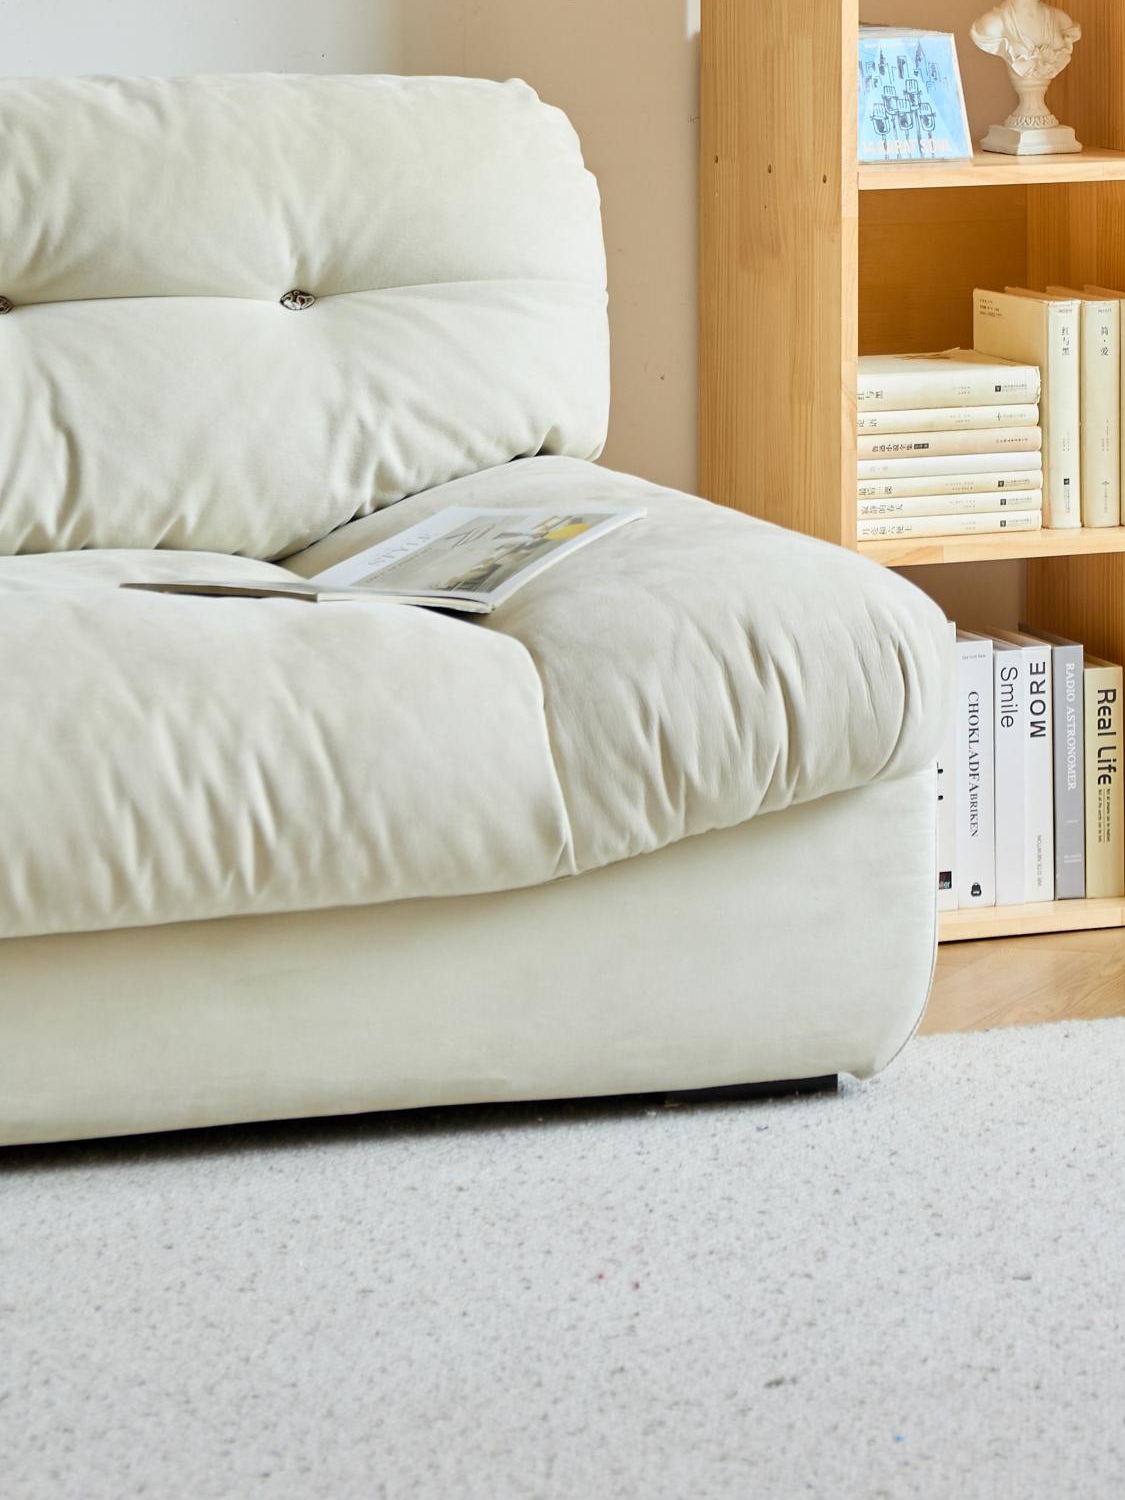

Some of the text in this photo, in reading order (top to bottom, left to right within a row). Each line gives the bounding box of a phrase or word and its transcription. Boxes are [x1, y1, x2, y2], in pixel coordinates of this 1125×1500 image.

[1000, 666, 1018, 728] Smile
[1030, 661, 1046, 738] MORE
[1065, 662, 1078, 790] RADIO ASTRONOMER
[1097, 688, 1117, 785] Real Life
